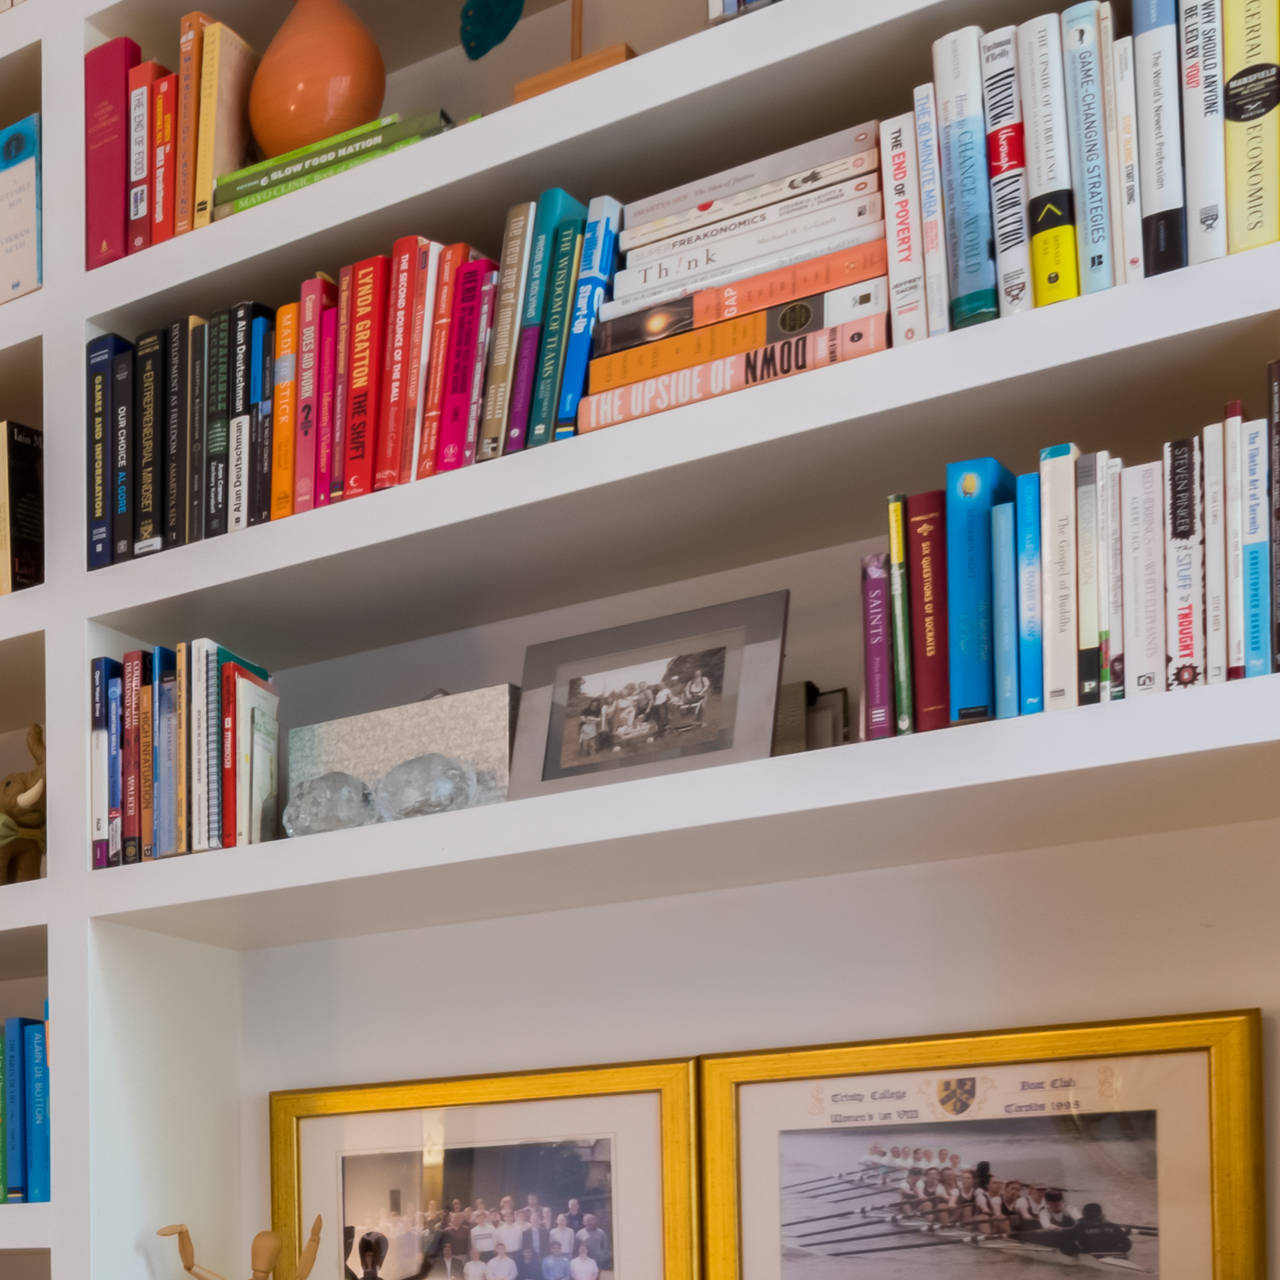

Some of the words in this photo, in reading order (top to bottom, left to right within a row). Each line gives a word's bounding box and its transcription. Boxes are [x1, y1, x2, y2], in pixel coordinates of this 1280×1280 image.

[1184, 6, 1197, 21] BE
[1201, 0, 1217, 24] WHY
[1184, 24, 1198, 46] LED
[1202, 28, 1218, 71] SHOULD
[1152, 51, 1162, 68] The
[1185, 47, 1199, 61] BY
[1152, 70, 1163, 104] World's
[1186, 62, 1200, 89] YOU?
[133, 92, 145, 111] THE
[916, 95, 928, 121] THE
[955, 94, 966, 118] How
[1078, 50, 1099, 161] GAME-CHANGING
[1203, 75, 1219, 117] ANYONE
[133, 114, 145, 133] END
[918, 123, 930, 137] 80
[958, 119, 967, 129] to
[1154, 105, 1165, 139] Newest
[133, 136, 145, 149] OF
[890, 128, 903, 151] THE
[133, 151, 145, 177] FOOD
[270, 161, 302, 181] SLOW
[304, 152, 335, 168] FOOD
[338, 135, 382, 156] NATION
[892, 153, 907, 181] END
[919, 140, 934, 187] MINUTE
[958, 130, 975, 198] CHANGE
[1155, 142, 1166, 189] Profession
[894, 183, 904, 197] OF
[1246, 124, 1264, 231] ECONOMICS
[924, 190, 937, 219] MBA
[962, 201, 974, 216] the
[1088, 164, 1106, 245] STRATEGIES
[511, 216, 524, 237] the
[560, 228, 574, 254] THE
[671, 213, 767, 250] FREAKONOMICS
[895, 200, 912, 264] POVERTY
[507, 240, 520, 264] new
[532, 234, 546, 278] PROBLEM
[580, 220, 600, 272] brilliant
[964, 216, 980, 274] WORLD
[399, 254, 409, 270] THE
[501, 267, 517, 289] age
[356, 266, 374, 317] LYNDA
[397, 272, 408, 309] SECOND
[462, 269, 478, 303] HERD
[503, 292, 515, 304] of
[527, 280, 541, 318] SOLVING
[551, 257, 570, 314] WISDOM
[549, 316, 563, 332] OF
[571, 284, 592, 334] Start-Up
[235, 320, 246, 344] Alan
[279, 314, 291, 355] MADE
[394, 310, 405, 347] BOUNCE
[495, 307, 513, 366] innovation
[352, 320, 372, 389] GRATTON
[392, 363, 402, 379] THE
[393, 349, 402, 361] OF
[542, 335, 559, 378] TEAMS
[94, 375, 103, 413] GAMES
[235, 346, 246, 412] Deutschman
[390, 382, 401, 402] BALL
[591, 393, 623, 428] THE
[631, 365, 704, 415] UPSIDE
[710, 355, 737, 394] OF
[744, 335, 808, 385] DOWN
[117, 406, 126, 421] OUR
[278, 382, 290, 424] STICK
[352, 391, 368, 417] THE
[94, 417, 103, 439] AND
[350, 418, 367, 461] SHIFT
[1248, 431, 1258, 445] The
[117, 423, 127, 468] CHOICE
[1248, 447, 1258, 475] Tibetan
[94, 443, 103, 518] INFORMATION
[117, 472, 126, 483] AL
[1174, 447, 1190, 490] STEVEN
[1248, 478, 1259, 490] Art
[117, 485, 127, 514] GORE
[1175, 492, 1191, 532] PINKER
[1247, 503, 1259, 536] Serenity
[921, 541, 931, 555] SIX
[921, 556, 933, 602] QUESTIONS
[1177, 554, 1190, 590] STUFF
[869, 589, 883, 644] SAINTS
[925, 604, 934, 615] OF
[925, 616, 936, 657] SOCRATES
[1177, 605, 1194, 660] THOUGHT
[143, 741, 152, 810] INFATUATION
[34, 1066, 43, 1080] DE
[35, 1082, 44, 1124] BOTTON
[831, 1093, 865, 1104] Trinity
[870, 1088, 907, 1100] College
[1020, 1079, 1045, 1091] Boat
[1050, 1077, 1076, 1089] Club
[830, 1111, 874, 1123] Women's
